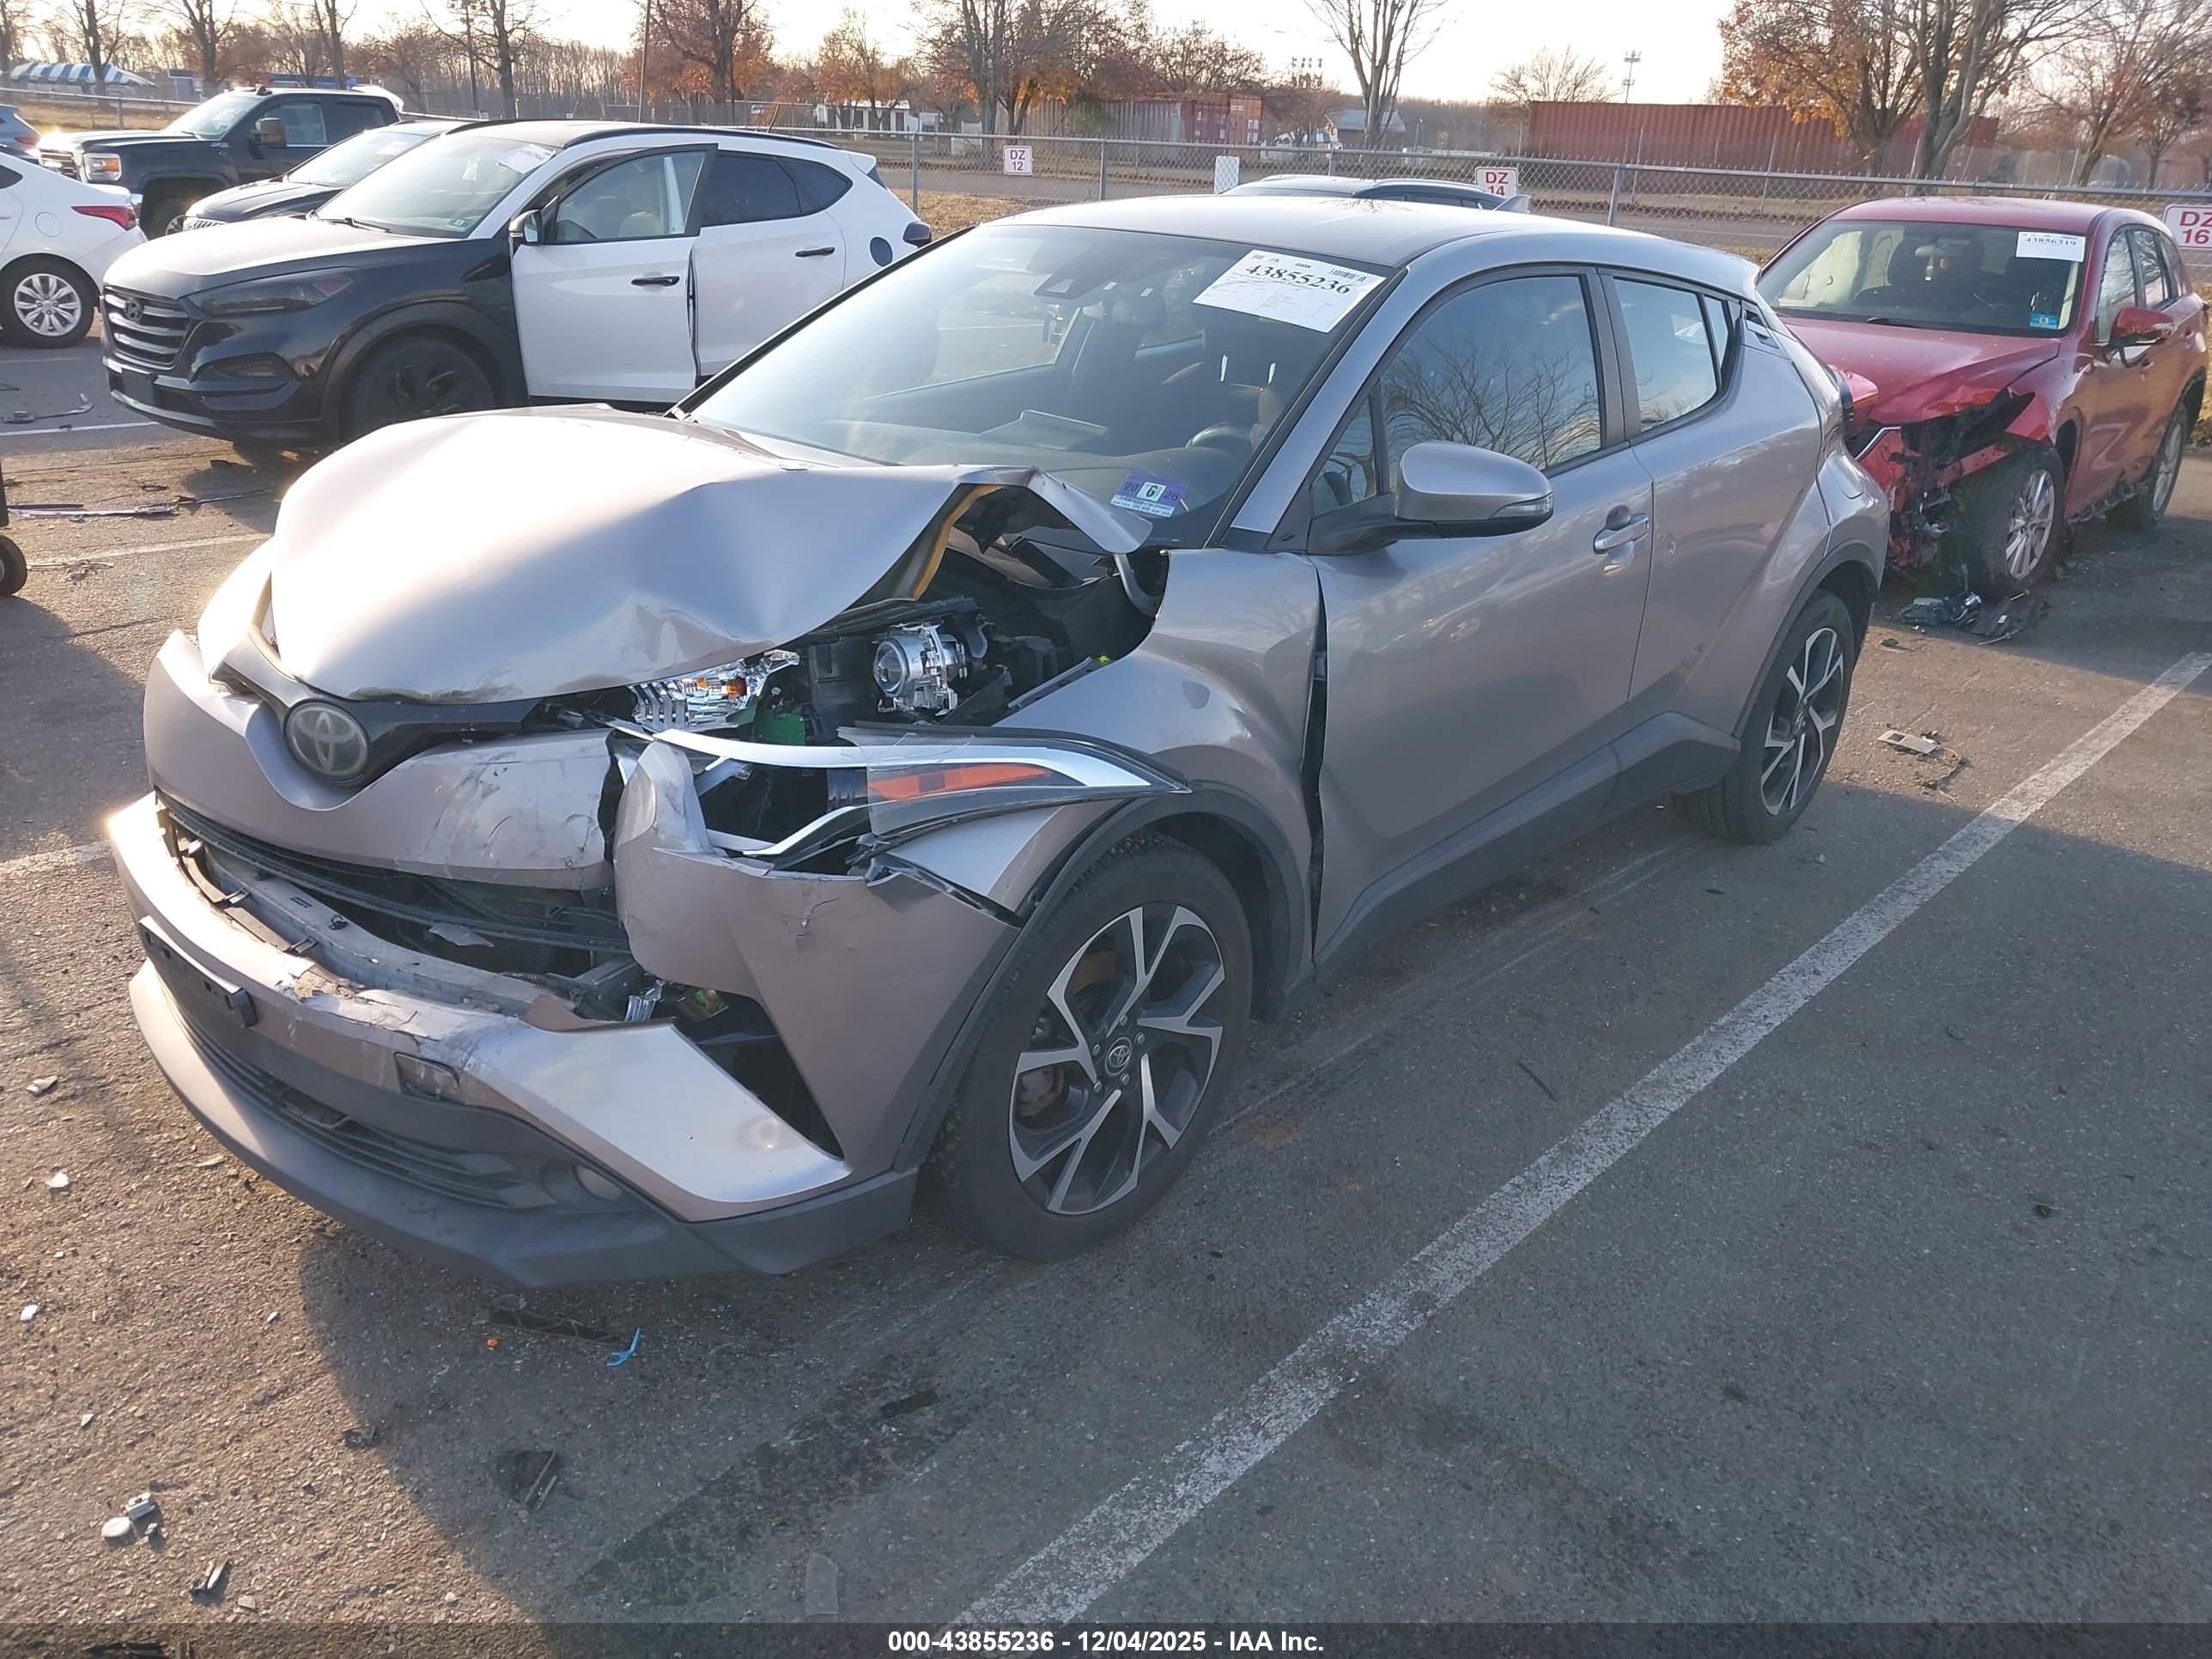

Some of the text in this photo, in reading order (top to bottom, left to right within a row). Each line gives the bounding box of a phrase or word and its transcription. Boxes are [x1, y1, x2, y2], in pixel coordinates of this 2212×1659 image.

[1010, 149, 1025, 160] DZ
[1012, 161, 1024, 171] 12
[1486, 172, 1509, 184] DZ
[1488, 185, 1505, 197] 14
[2182, 229, 2210, 244] 16
[1246, 264, 1352, 294] 43855236
[1123, 482, 1139, 492] 20
[1146, 485, 1158, 497] 6
